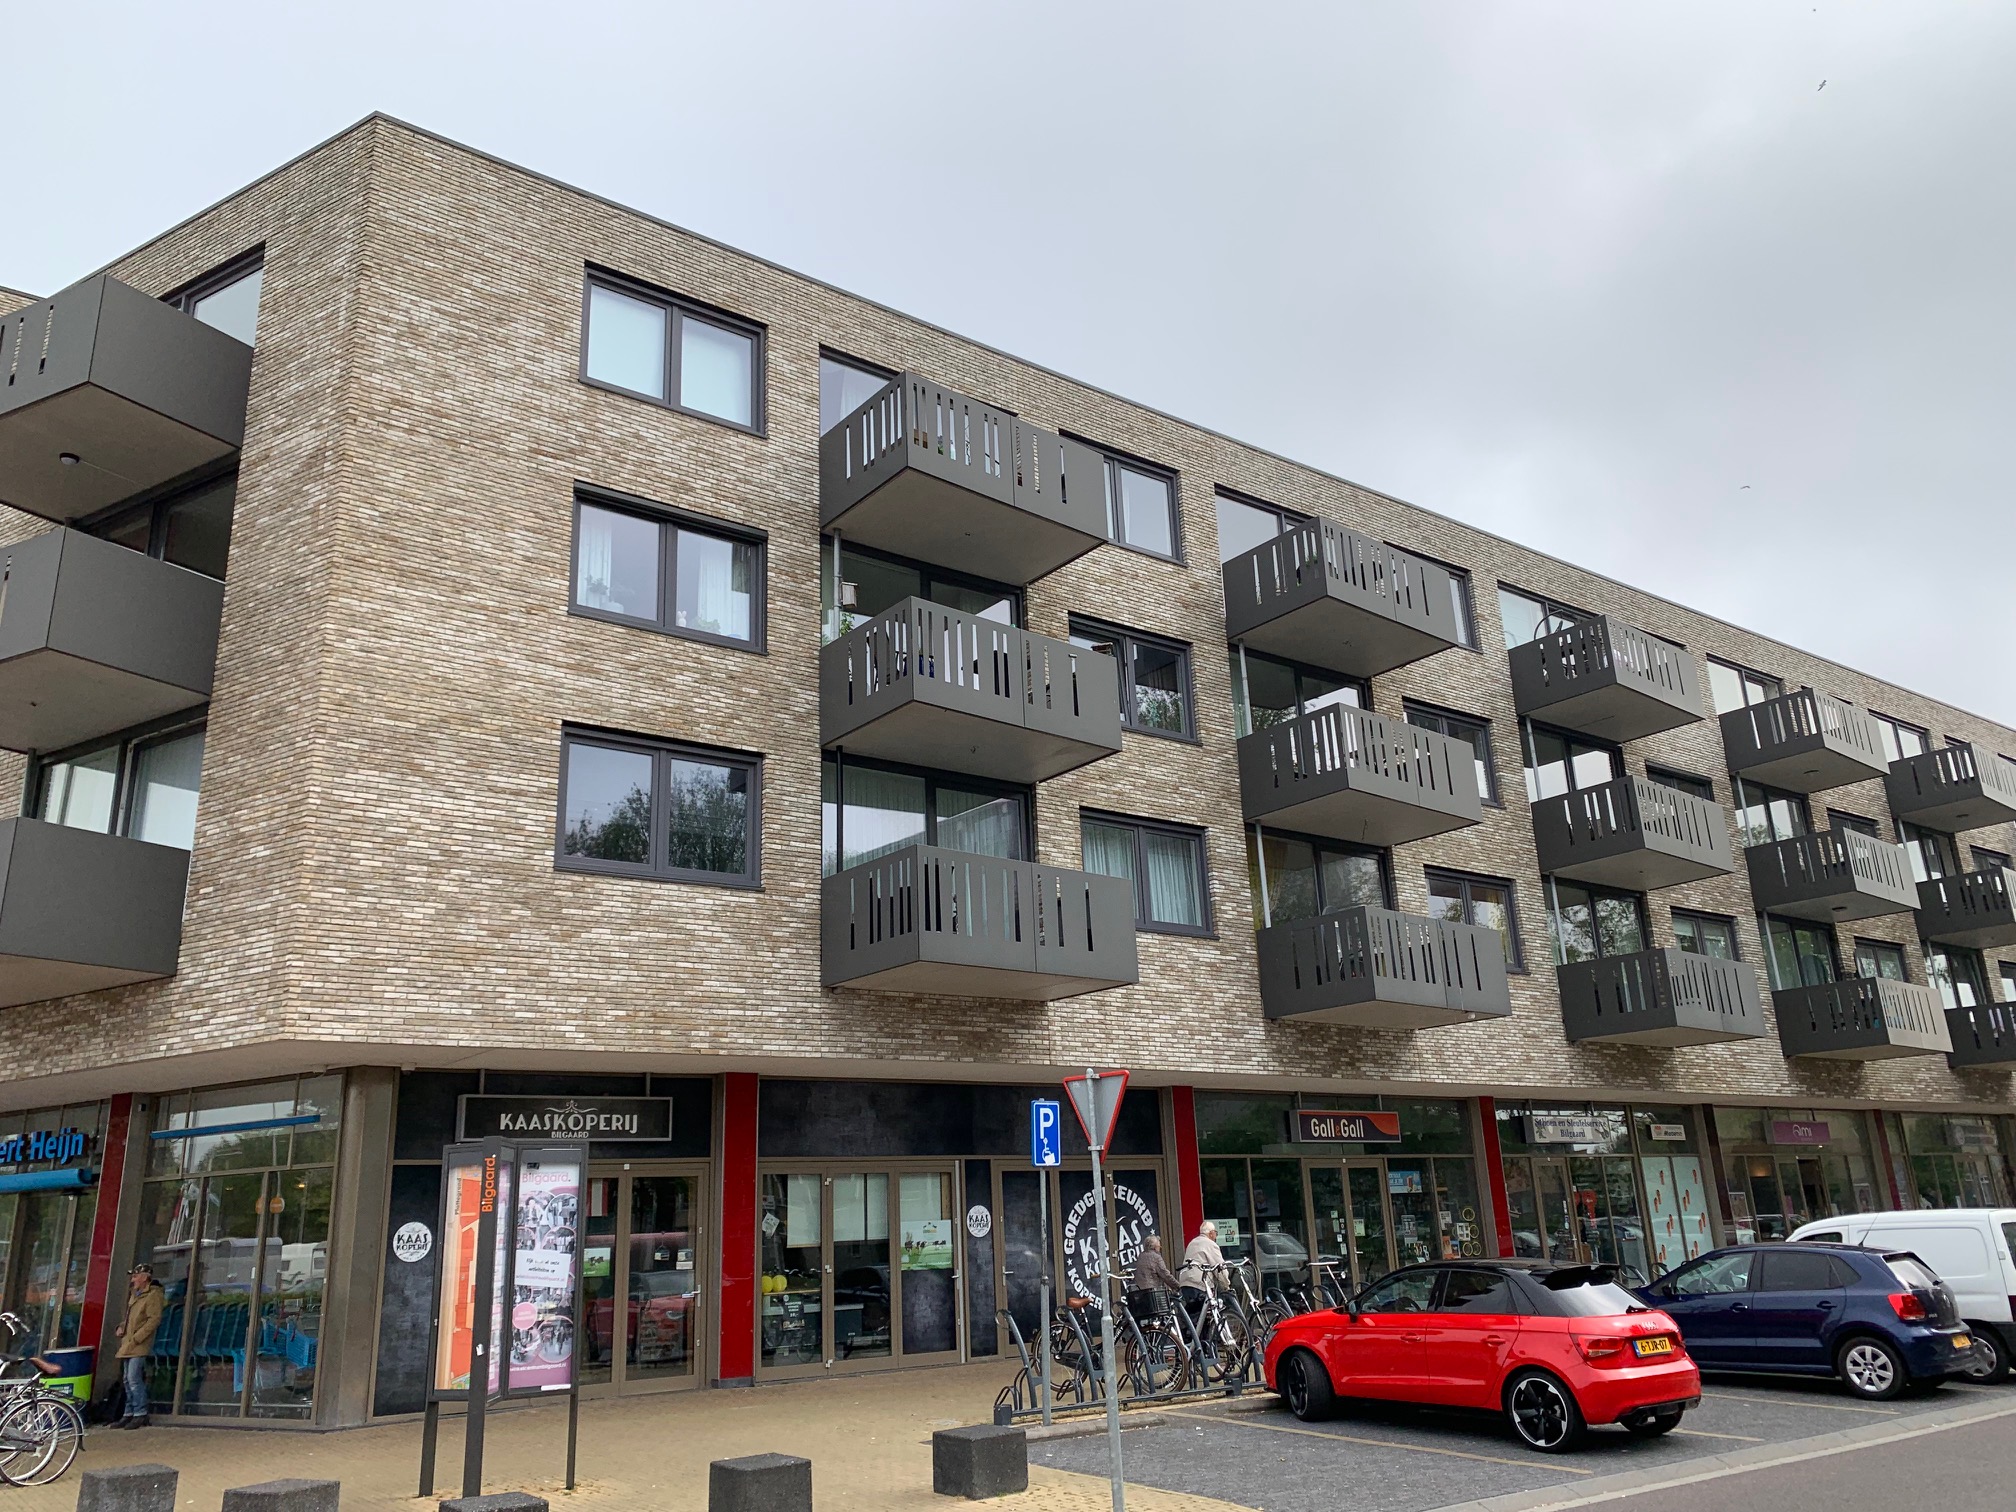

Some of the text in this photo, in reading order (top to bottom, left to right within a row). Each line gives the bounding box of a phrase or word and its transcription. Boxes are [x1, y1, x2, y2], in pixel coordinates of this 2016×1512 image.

[500, 1113, 638, 1134] KAASKOPERIJ
[1040, 1107, 1054, 1139] P
[551, 1131, 589, 1139] BILGAARD
[1560, 1129, 1586, 1139] Bilgaard
[29, 1127, 84, 1165] Heijn
[969, 1214, 989, 1223] KAAS
[397, 1233, 428, 1244] KAAS
